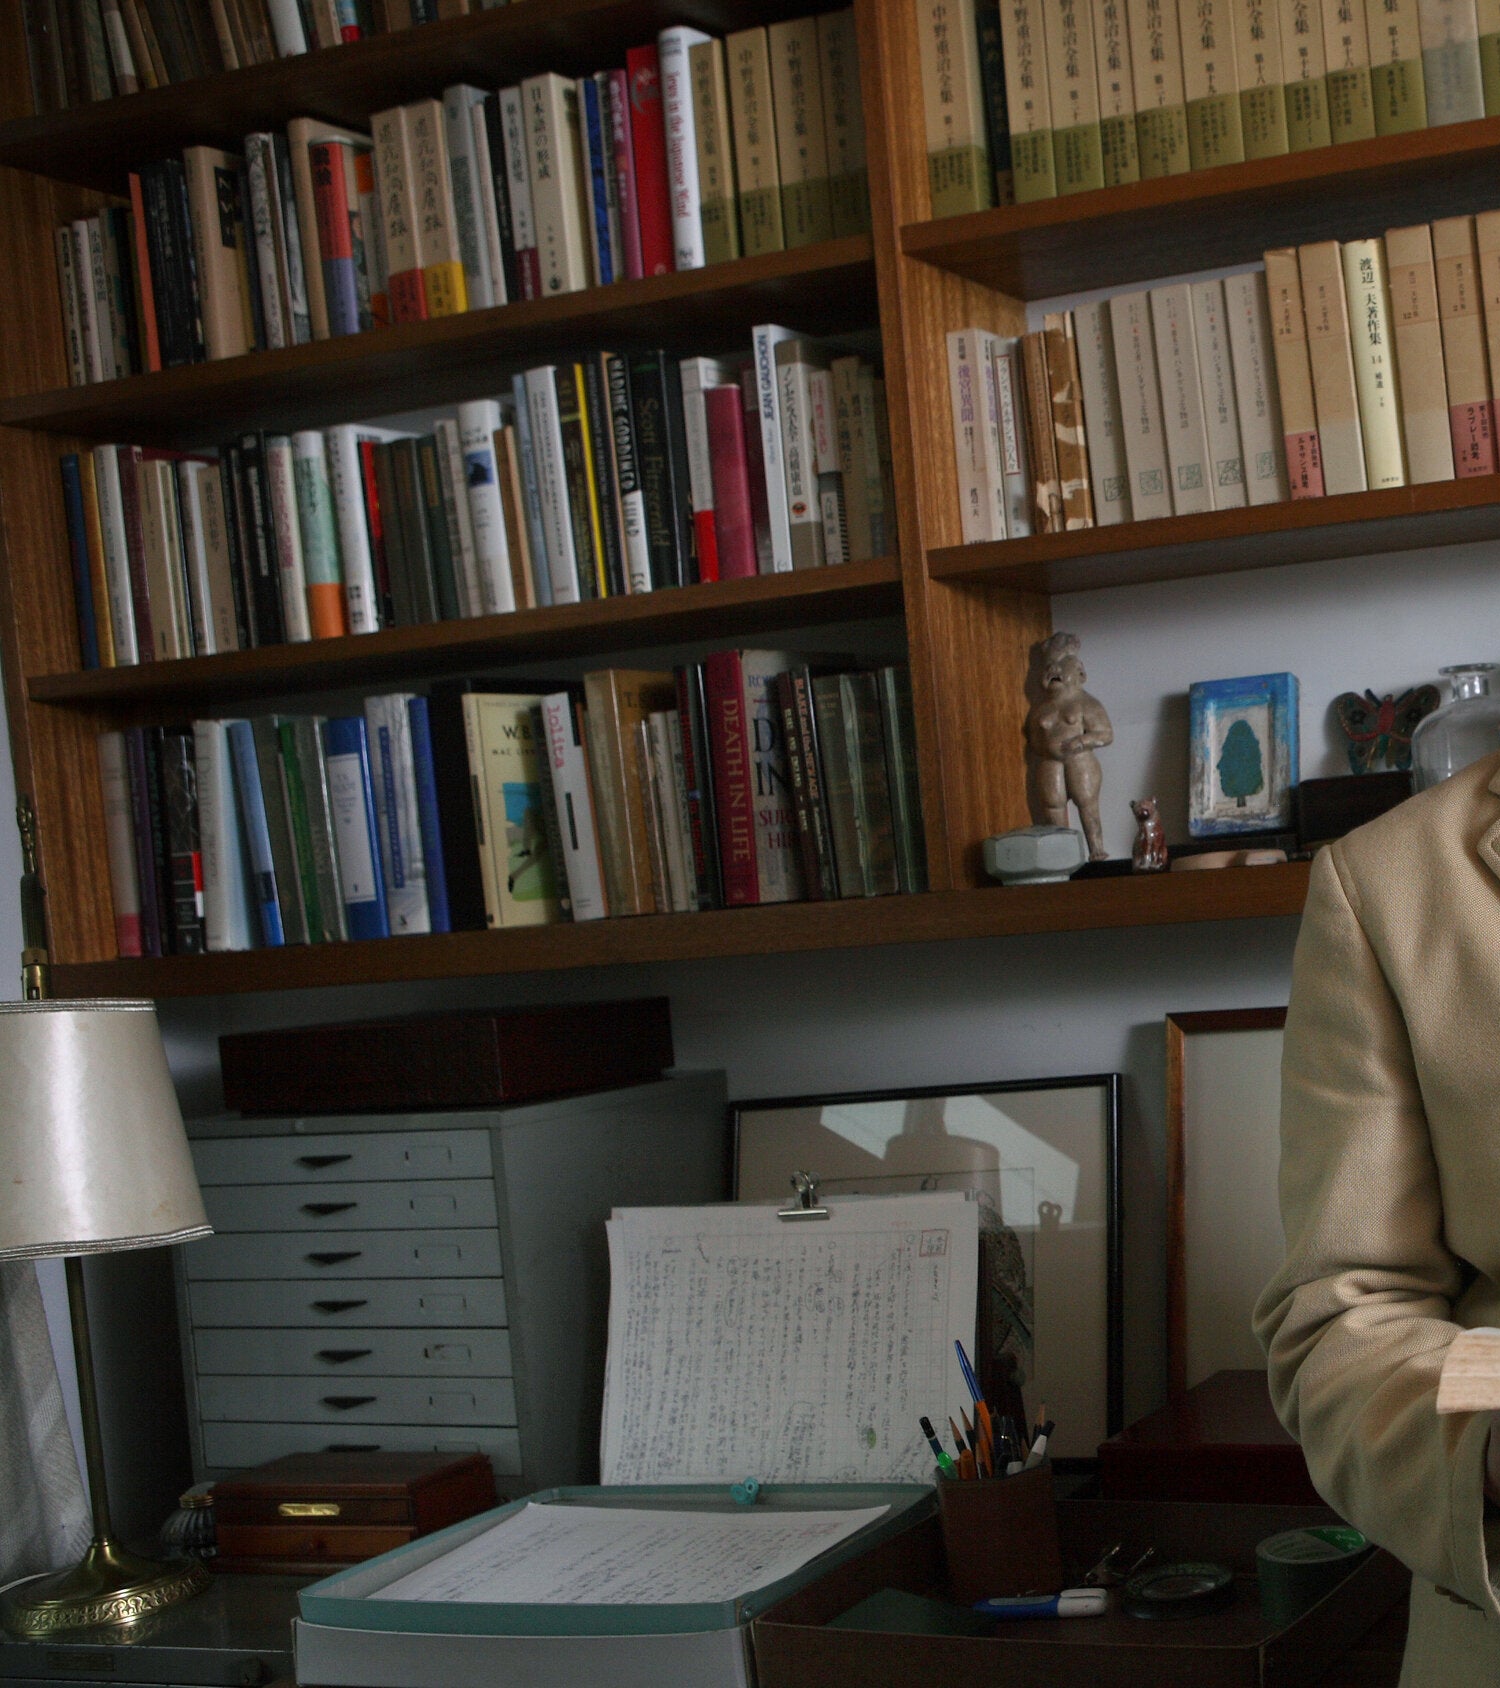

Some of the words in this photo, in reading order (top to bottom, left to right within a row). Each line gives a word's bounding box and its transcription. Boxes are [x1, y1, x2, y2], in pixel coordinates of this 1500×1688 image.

[1359, 257, 1383, 346] 渡辺一夫著作集
[1371, 354, 1383, 365] 14
[546, 704, 565, 770] lolita
[722, 699, 743, 776] DEATH
[727, 783, 745, 809] IN
[731, 816, 751, 863] LIFE
